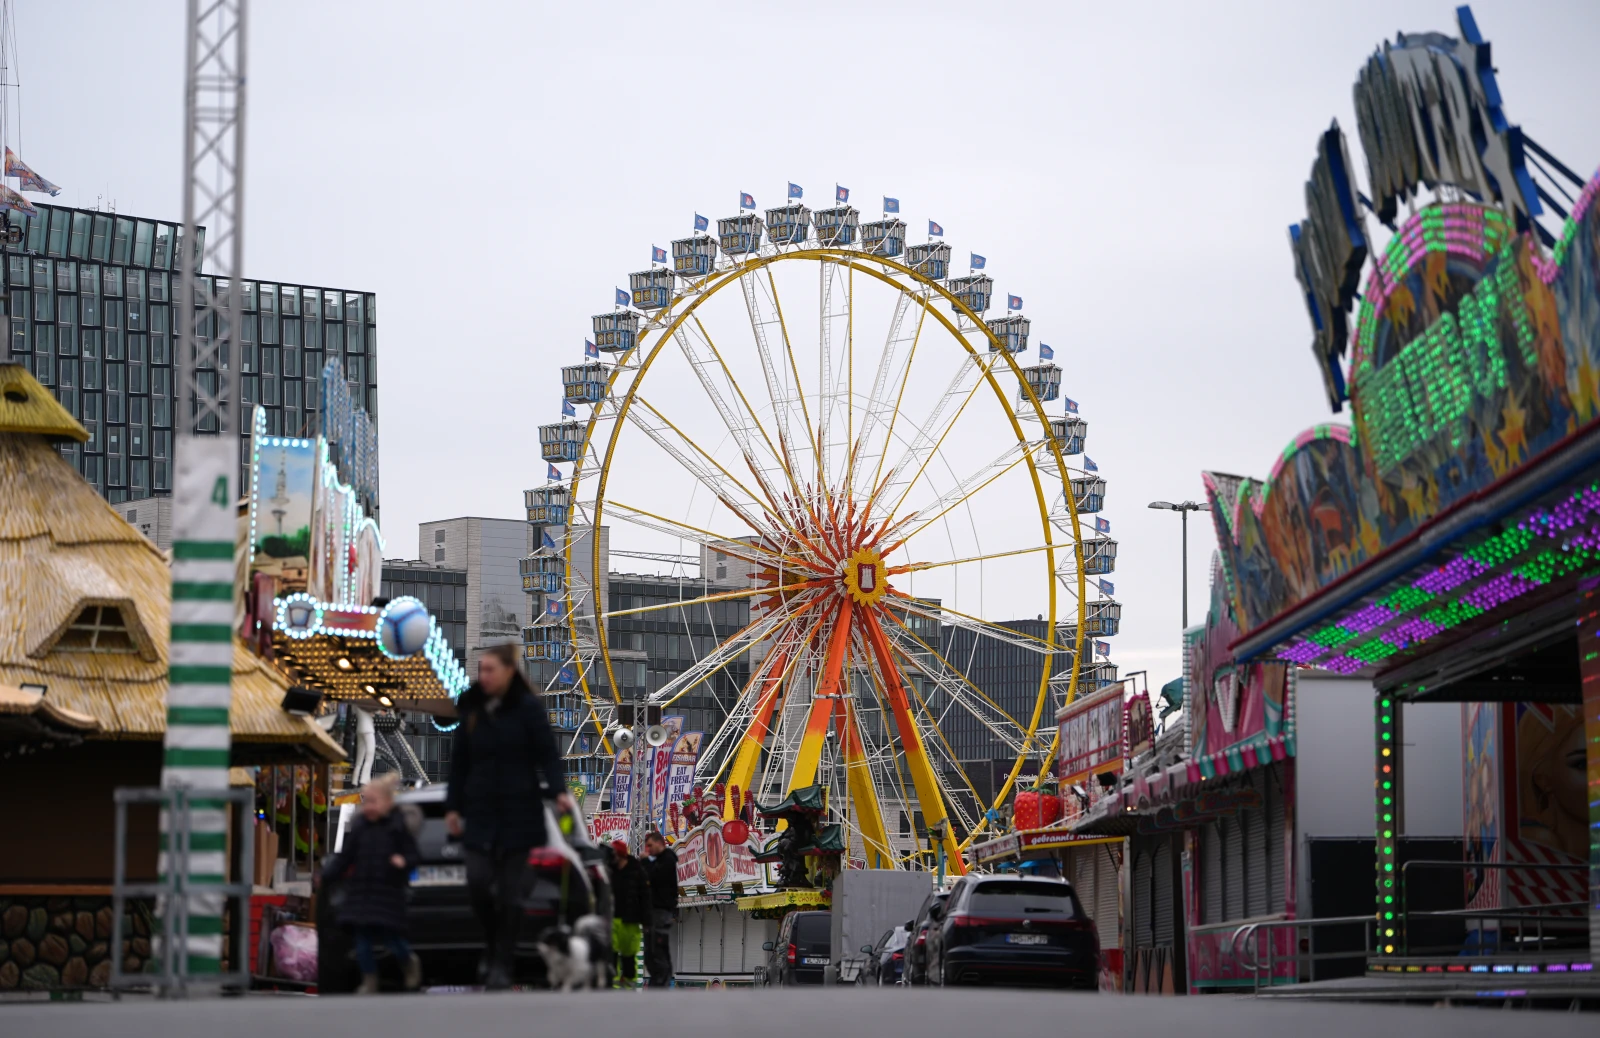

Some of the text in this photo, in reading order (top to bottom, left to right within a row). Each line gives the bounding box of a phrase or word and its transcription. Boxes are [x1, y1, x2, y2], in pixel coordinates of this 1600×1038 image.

[211, 475, 228, 508] 4
[672, 754, 696, 762] FISHBAR
[676, 766, 686, 774] EAT
[670, 776, 690, 784] FRESH.
[674, 786, 684, 794] EAT
[594, 818, 631, 838] BACKFISCH
[1031, 833, 1075, 846] gebrannte
